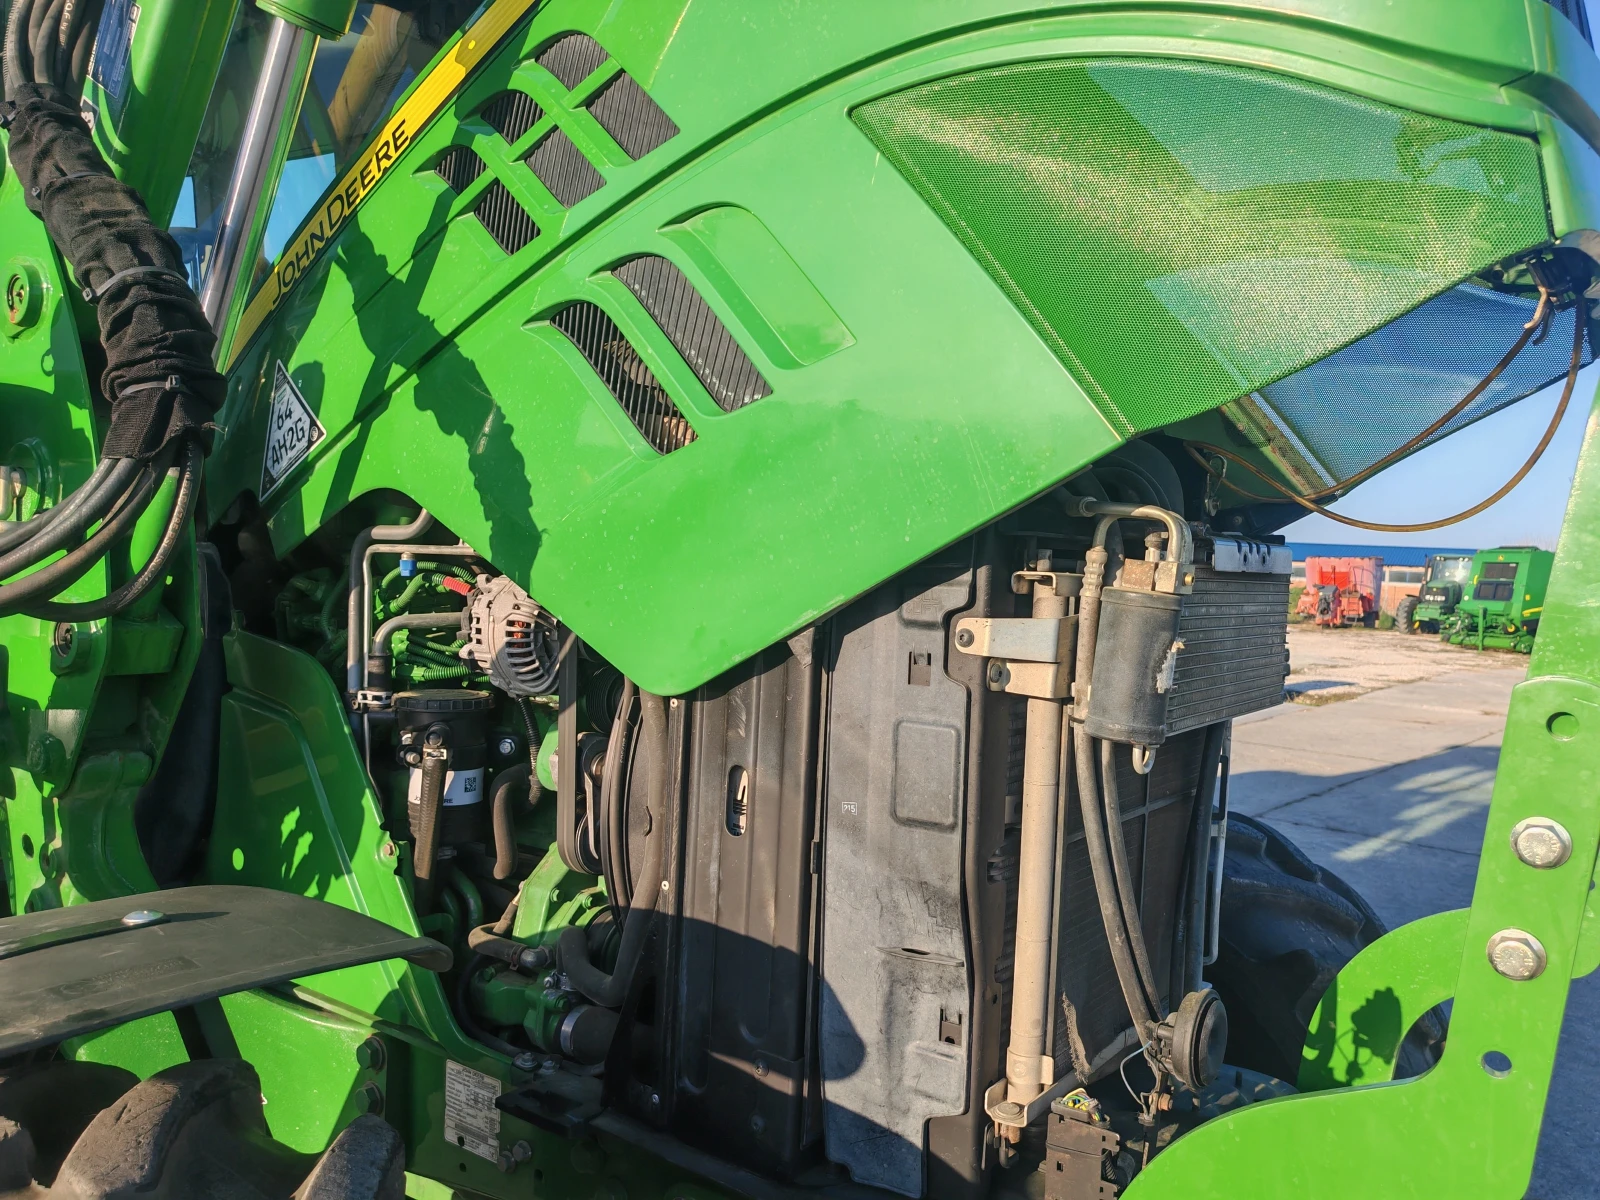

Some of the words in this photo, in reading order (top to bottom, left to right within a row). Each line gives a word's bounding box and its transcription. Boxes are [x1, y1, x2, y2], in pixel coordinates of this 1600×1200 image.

[272, 220, 327, 304] JOHN
[327, 119, 409, 231] DEERE
[276, 398, 293, 431] 64
[271, 418, 306, 471] AH2G
